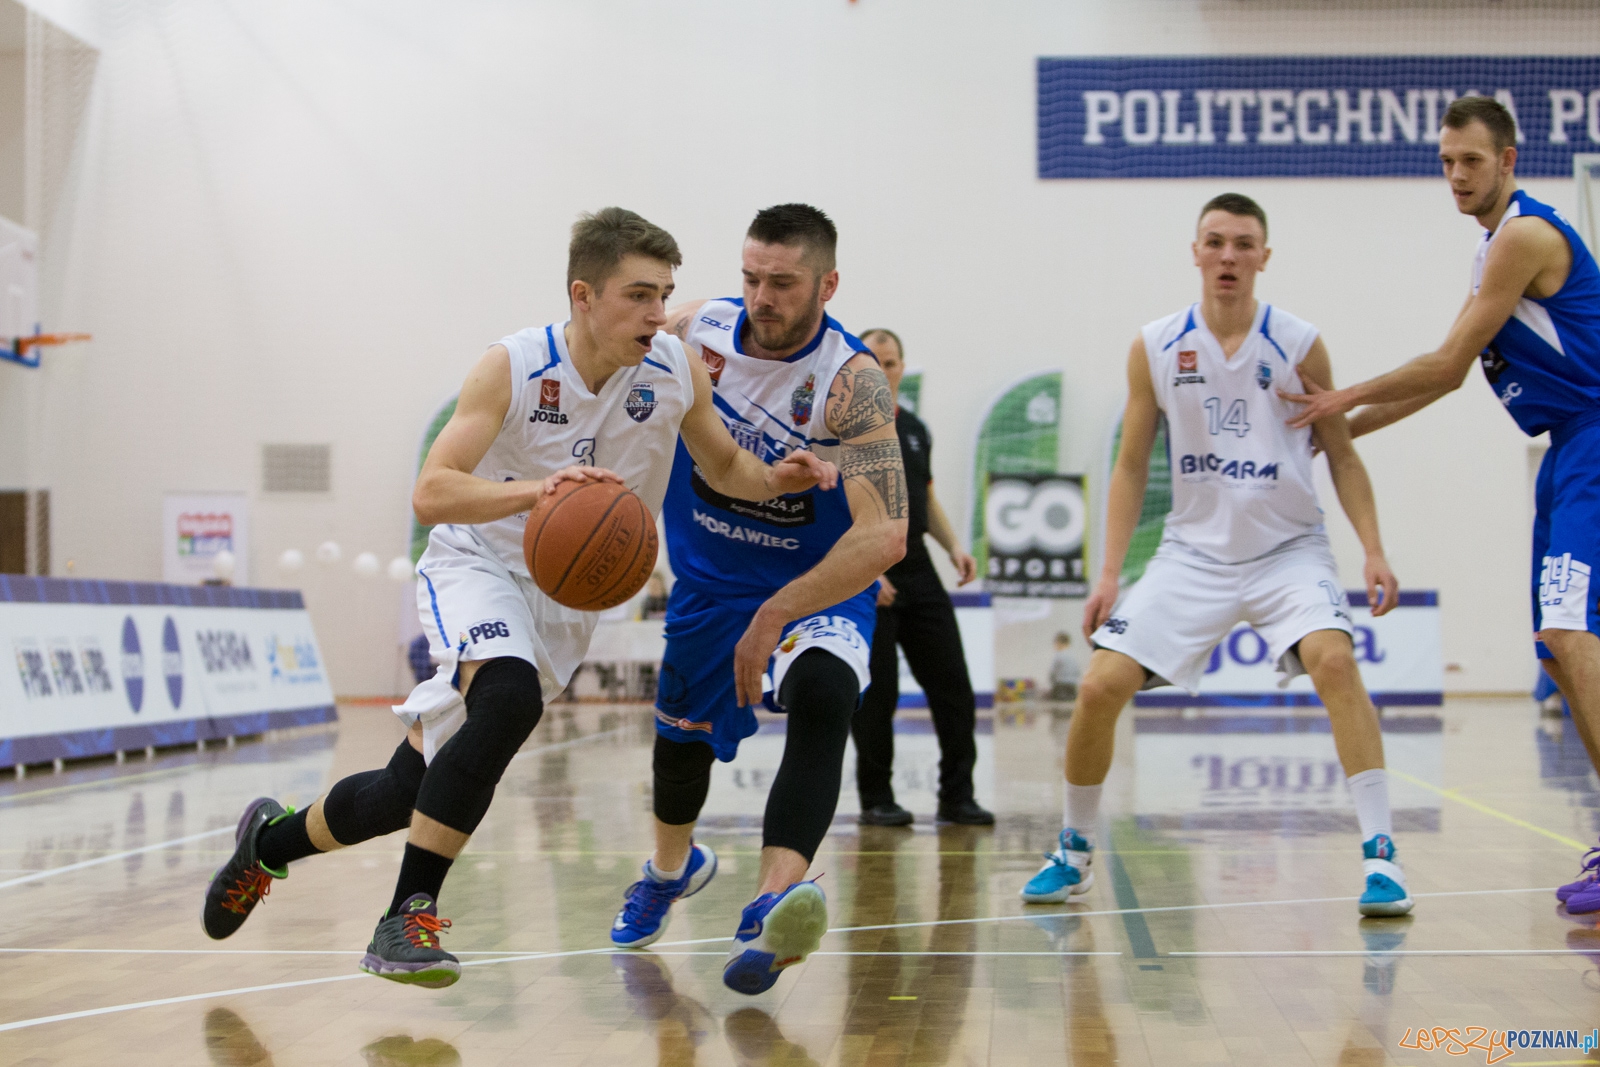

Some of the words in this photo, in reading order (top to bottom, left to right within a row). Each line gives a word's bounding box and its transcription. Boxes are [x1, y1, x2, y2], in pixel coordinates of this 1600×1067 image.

[1083, 90, 1525, 145] POLITECHNIA
[1203, 397, 1251, 438] 14
[572, 438, 596, 467] 3
[692, 508, 800, 550] MORAWIEC
[986, 479, 1085, 554] GO
[988, 558, 1084, 579] SPORT
[1318, 580, 1347, 606] 1
[468, 621, 510, 645] PBG
